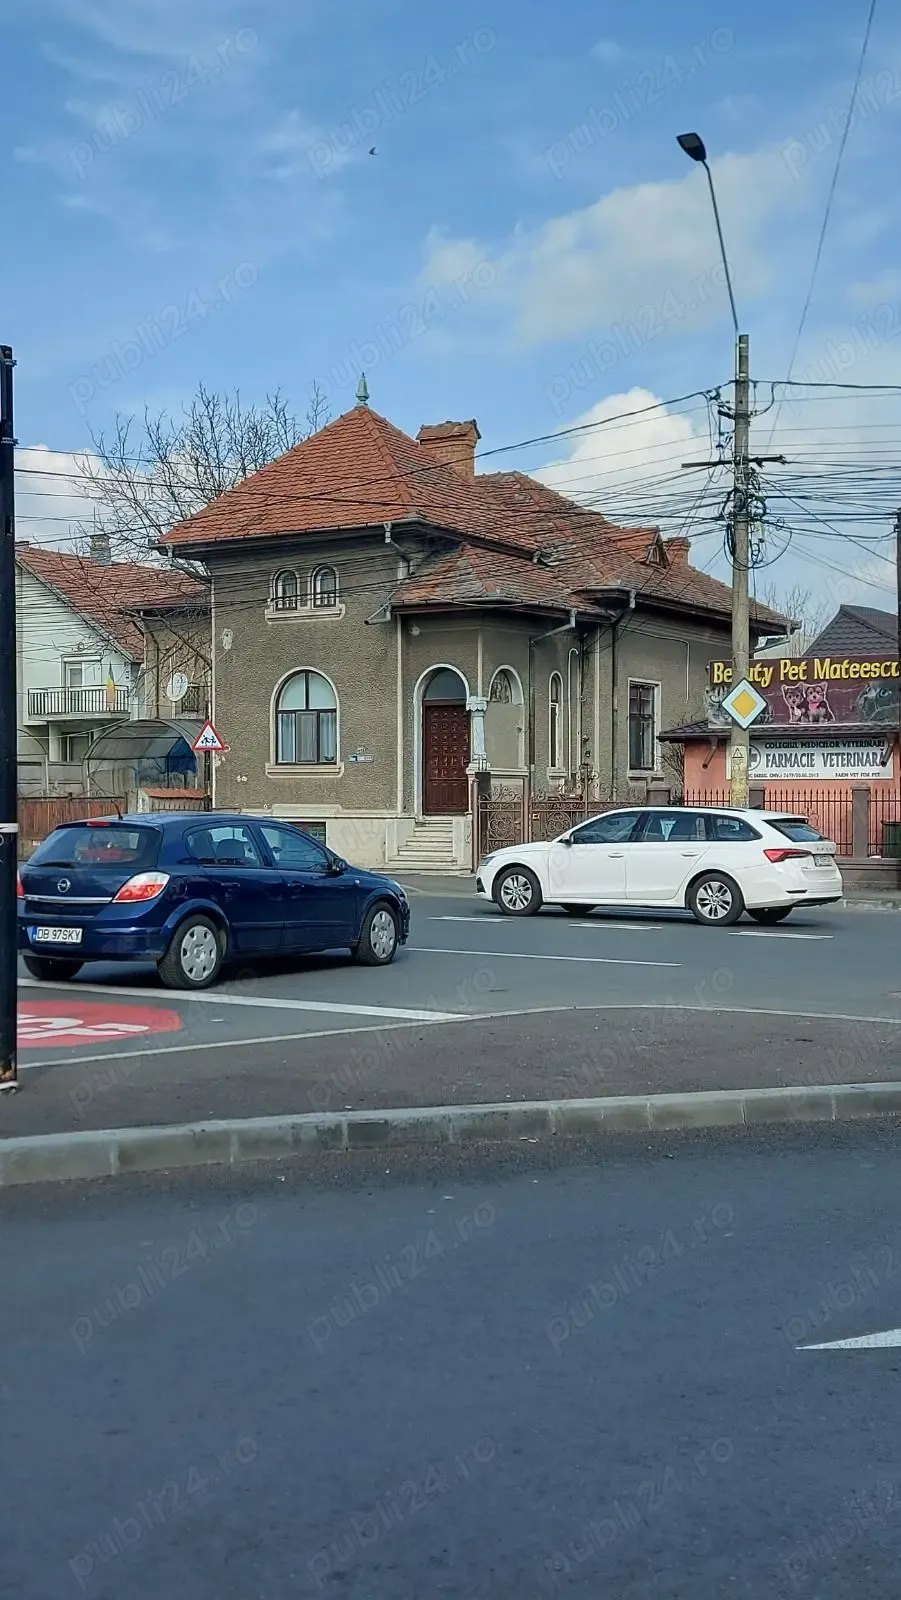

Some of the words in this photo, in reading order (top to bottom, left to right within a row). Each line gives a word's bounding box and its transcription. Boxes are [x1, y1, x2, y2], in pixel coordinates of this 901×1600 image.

[713, 662, 774, 688] Bety
[780, 659, 808, 681] Pet
[765, 741, 799, 749] COLEGIUL
[800, 740, 840, 749] MEDICILOR
[841, 739, 885, 748] VETERINARI
[765, 752, 815, 768] FARMACIE
[52, 928, 81, 941] 97SKY
